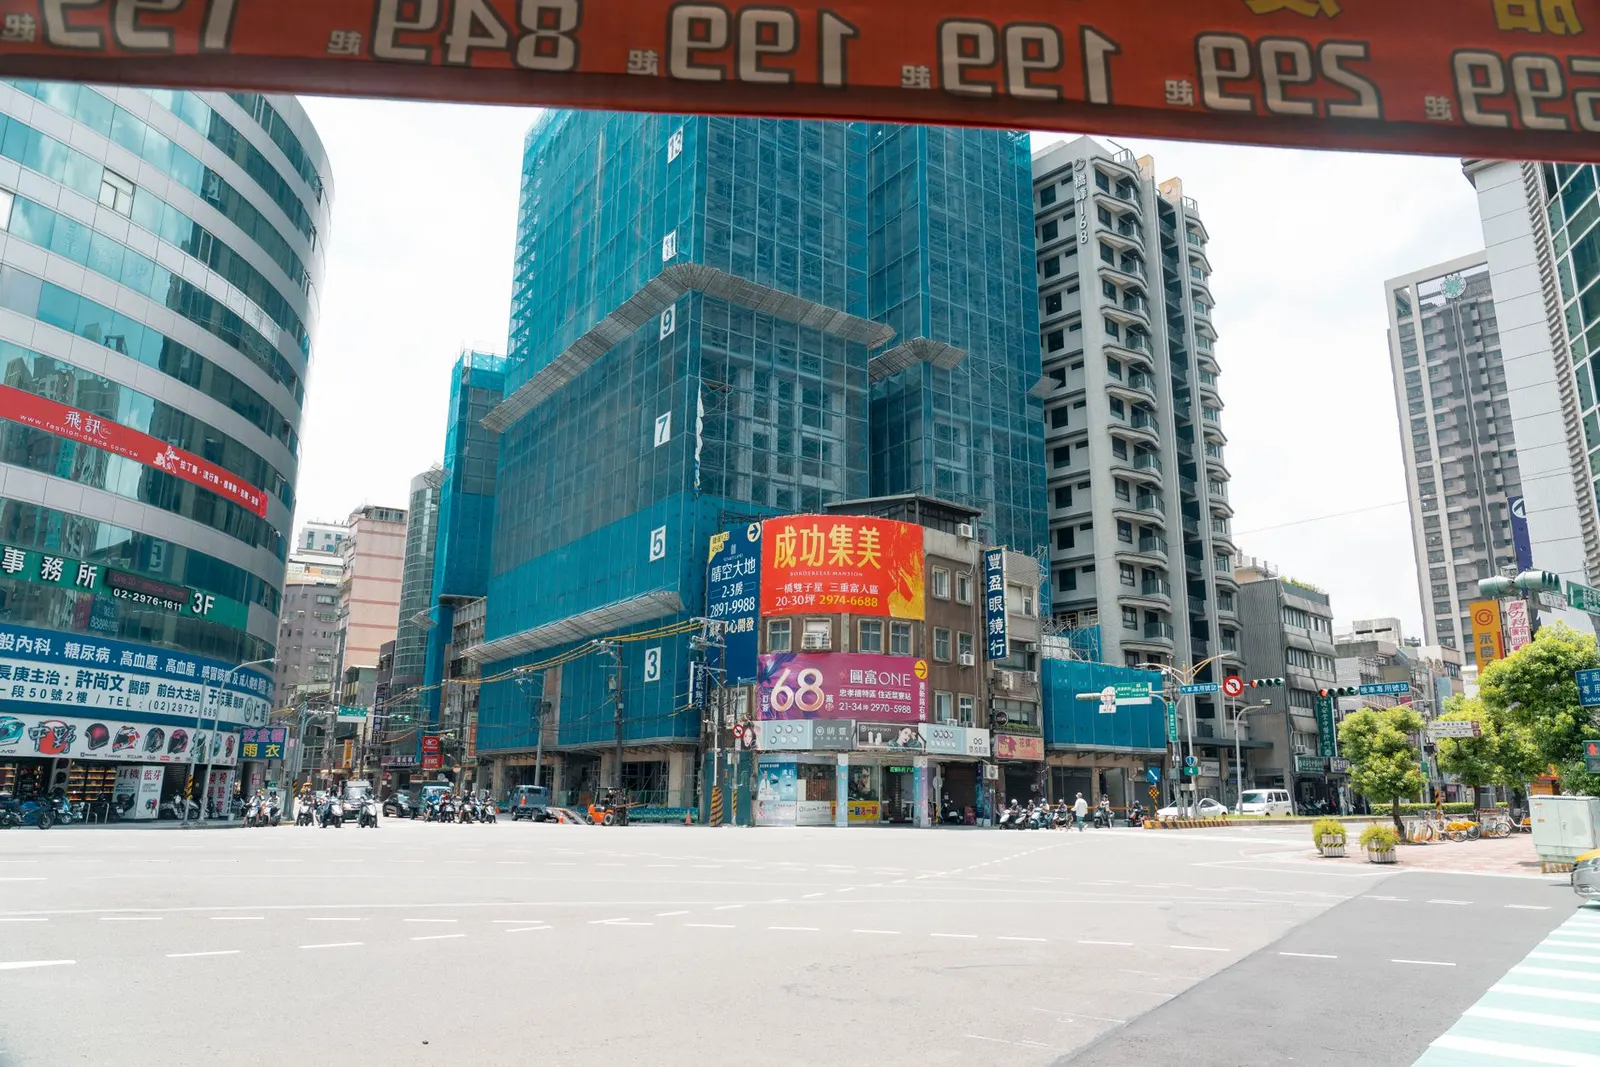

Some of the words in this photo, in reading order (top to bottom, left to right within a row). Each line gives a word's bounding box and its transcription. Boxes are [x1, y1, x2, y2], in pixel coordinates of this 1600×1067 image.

[670, 130, 682, 160] 13
[662, 307, 673, 336] 9
[657, 415, 669, 443] 7
[652, 529, 663, 559] 5
[774, 523, 882, 570] 成功集美
[1, 547, 98, 589] 事務所
[711, 557, 756, 582] 晴空大地
[113, 588, 182, 612] 02-2976-1611
[721, 581, 743, 599] 2-3房
[775, 582, 823, 594] 一橋雙子星
[829, 582, 879, 595] 三重富人區
[775, 594, 815, 607] 20-30坪
[819, 595, 878, 607] 2974-6688
[191, 591, 215, 616] 3F
[709, 596, 755, 619] 2891-9988
[988, 553, 1005, 657] 豐盈眼鏡行
[64, 641, 111, 664] 糖尿病
[120, 650, 158, 671] 高血壓
[165, 657, 196, 677] 高血脂
[646, 648, 658, 679] 3
[76, 669, 125, 693] 許尚文
[128, 679, 150, 695] 醫師
[157, 683, 200, 703] 前台大主治
[770, 667, 825, 712] 68
[1180, 683, 1218, 694] 汽車專用號誌
[1360, 683, 1408, 695] 機車專用號誌
[839, 702, 869, 712] 21-34坪
[870, 703, 912, 714] 2970-5988
[242, 728, 285, 743] 安全帽
[242, 743, 280, 757] 雨衣
[117, 768, 139, 780] 耳機
